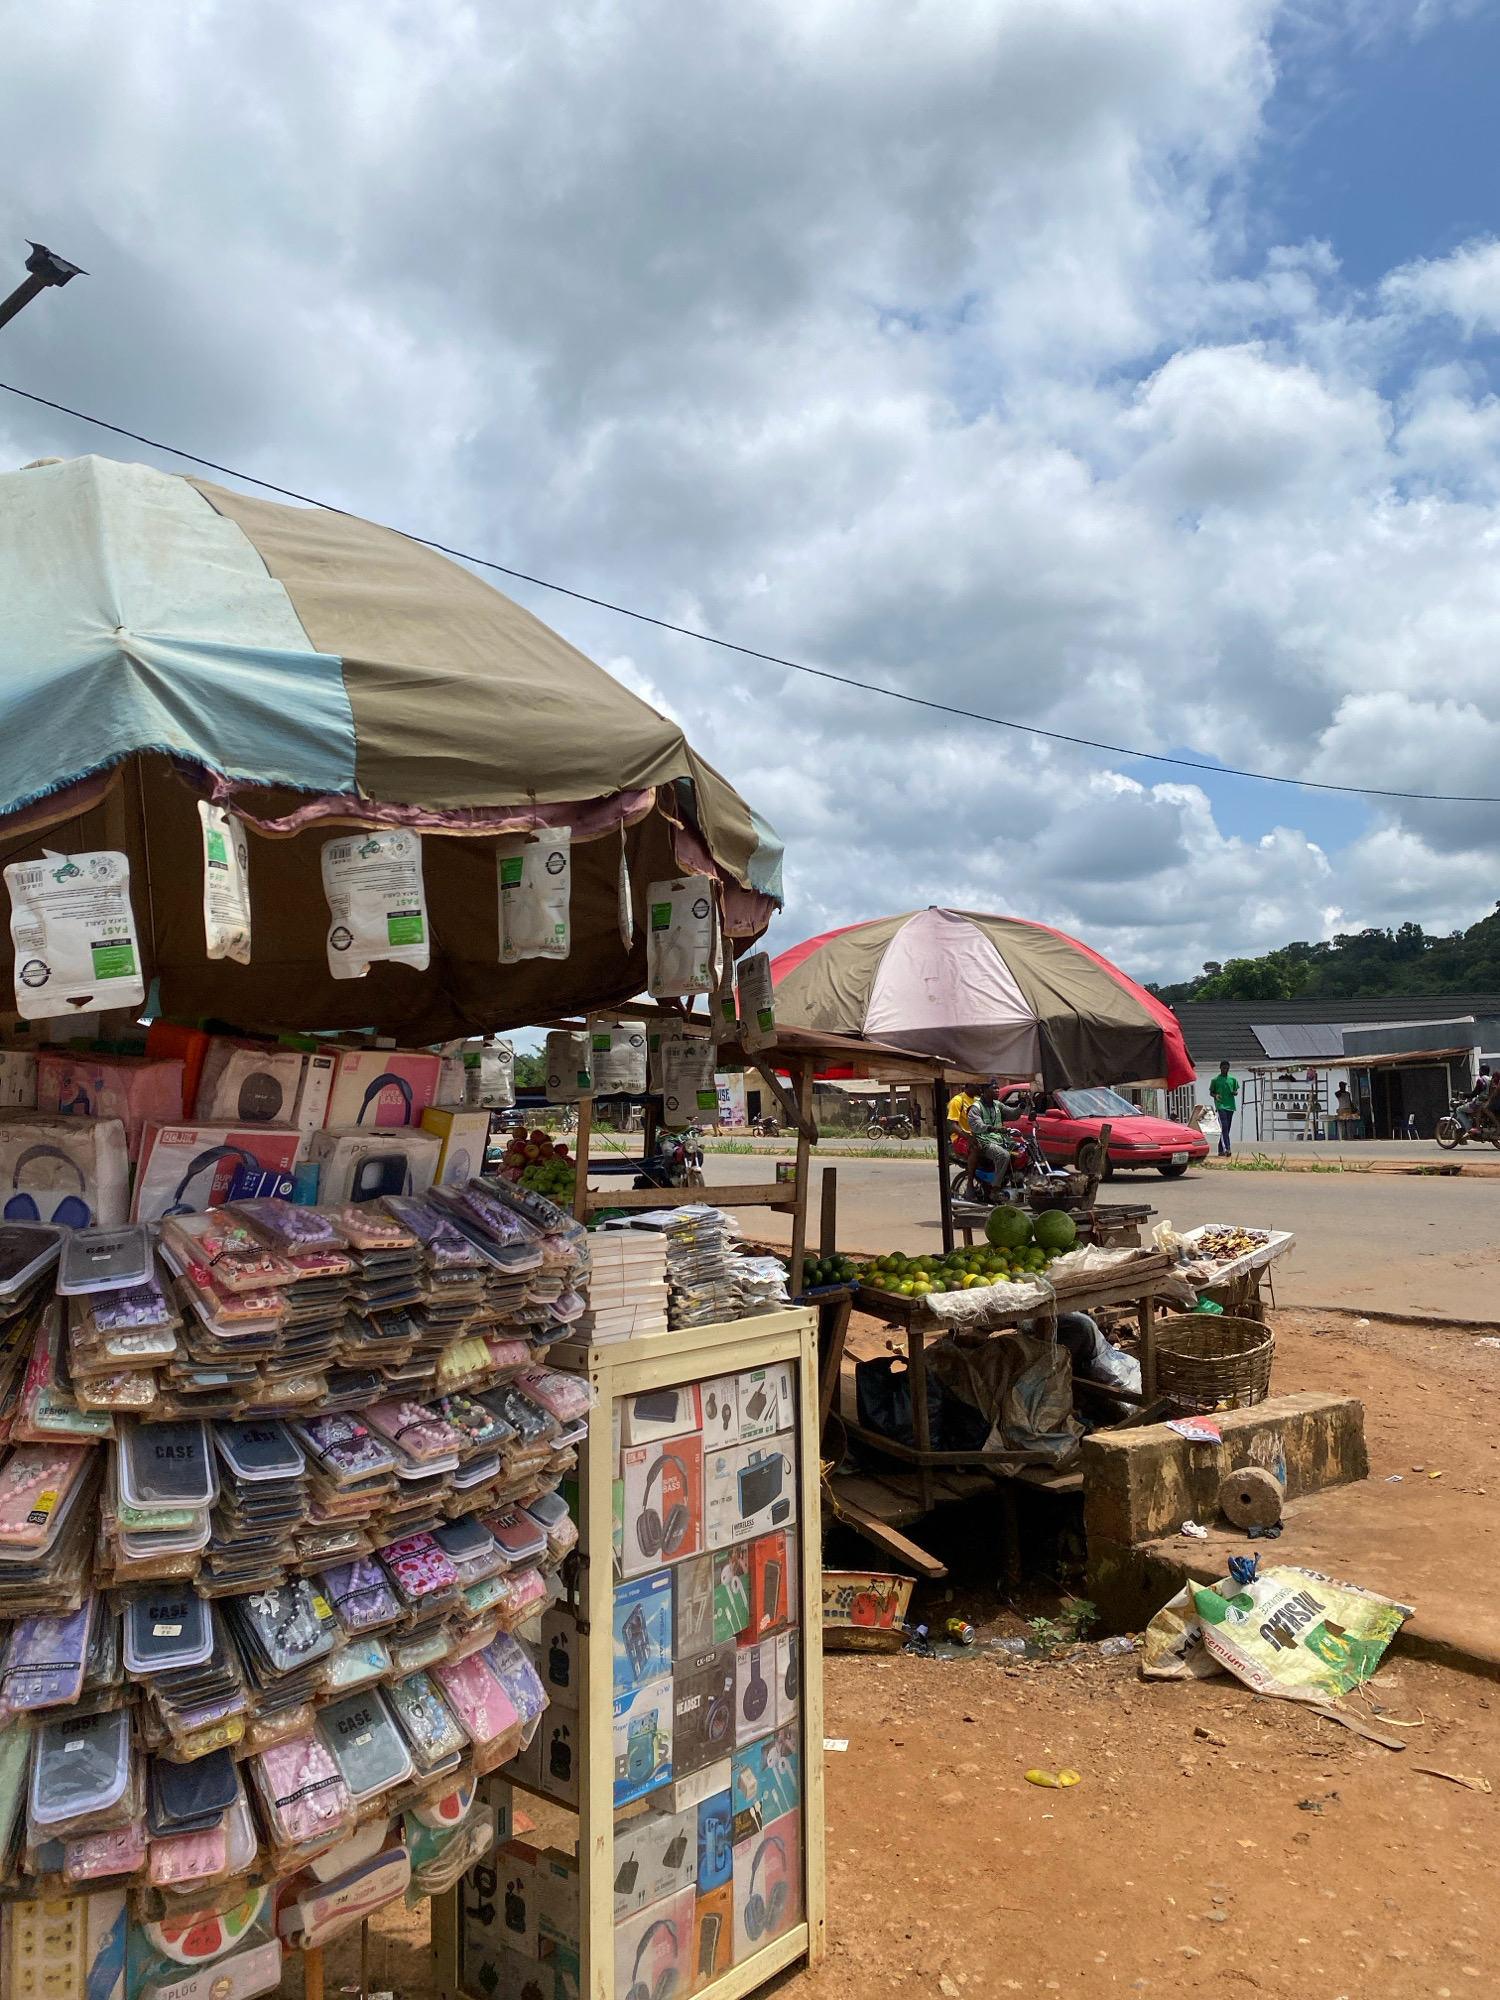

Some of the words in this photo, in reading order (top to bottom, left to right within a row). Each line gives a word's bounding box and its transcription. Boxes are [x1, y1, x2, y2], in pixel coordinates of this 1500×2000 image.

[102, 926, 128, 936] FAST
[380, 1096, 402, 1105] BASS
[86, 1243, 124, 1254] CASE
[39, 1407, 68, 1416] DESIGN
[155, 1445, 194, 1459] CASE
[663, 1481, 681, 1493] BASS
[734, 1518, 755, 1531] WIRELESS
[149, 1603, 188, 1619] CASE
[676, 1695, 701, 1716] HEADSET
[337, 1708, 373, 1735] CASE
